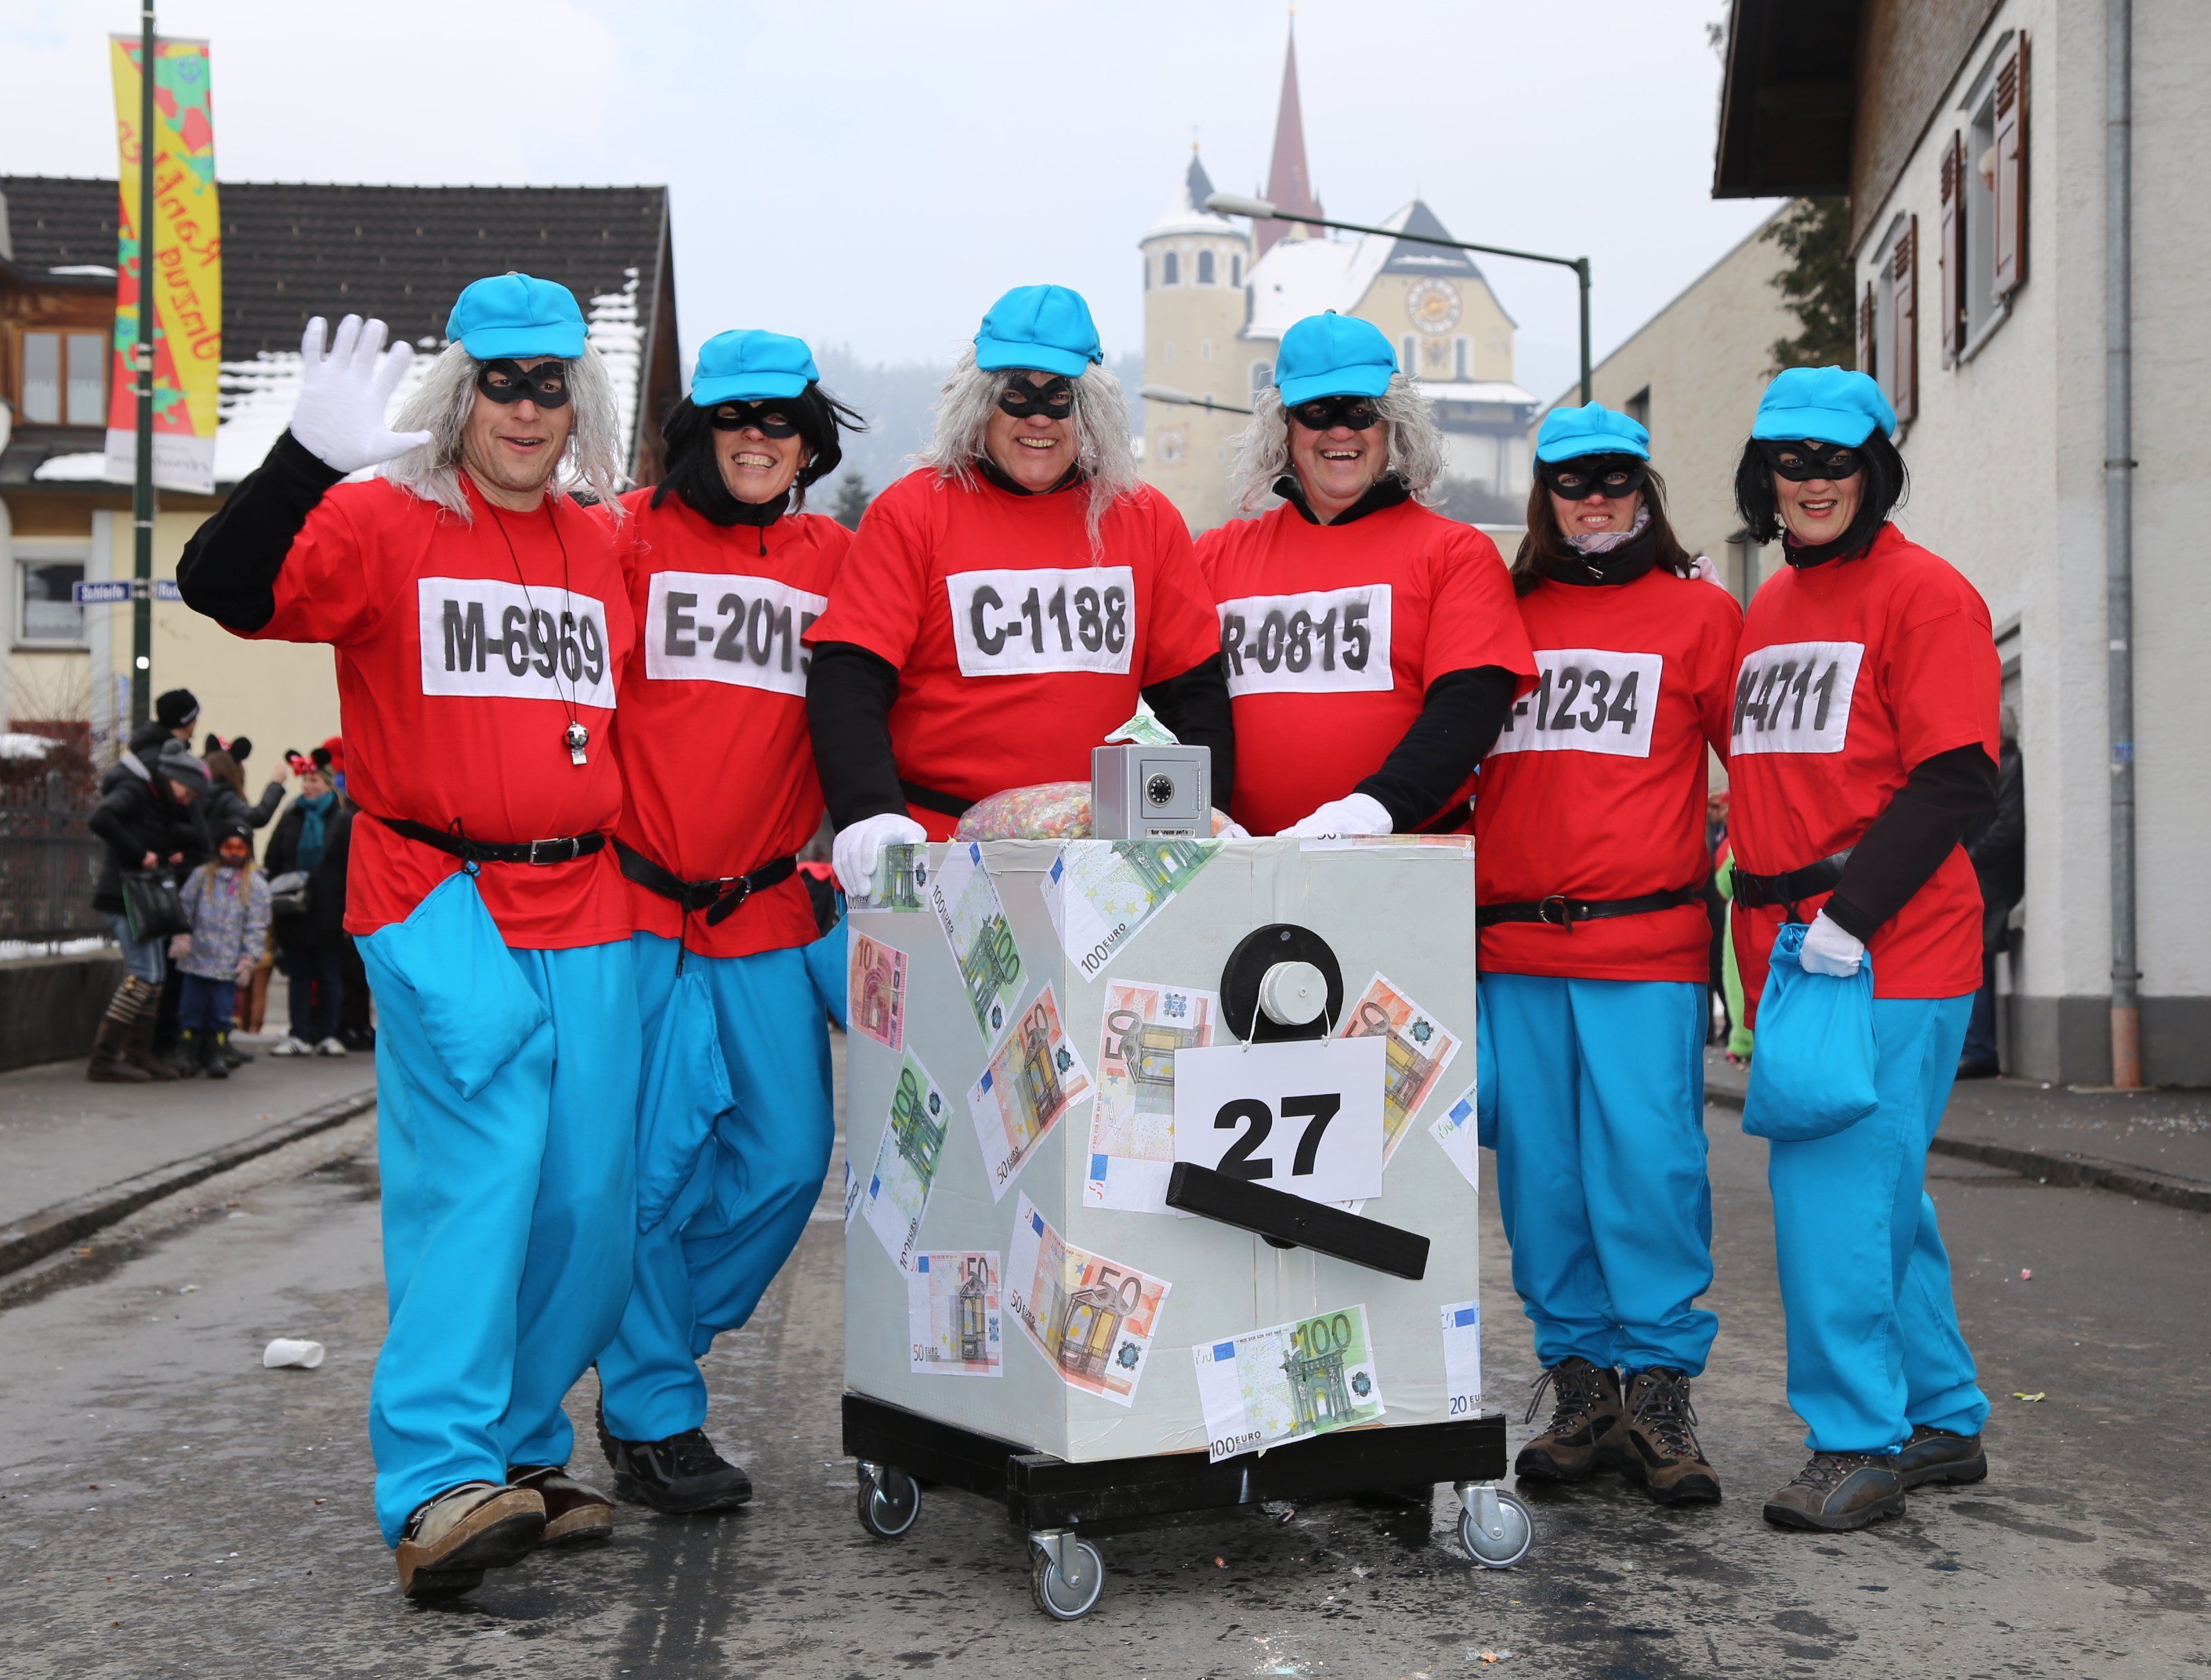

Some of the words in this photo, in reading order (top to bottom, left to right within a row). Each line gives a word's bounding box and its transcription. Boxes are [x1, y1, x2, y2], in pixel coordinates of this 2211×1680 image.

[443, 599, 604, 685] M-6969
[971, 586, 1126, 656] C-1188
[1221, 604, 1371, 679] R-0815
[1502, 666, 1640, 734] -1234
[932, 885, 946, 913] 100
[942, 908, 954, 933] EURO
[858, 937, 873, 971] 10
[991, 919, 1020, 986] 100
[1081, 944, 1109, 974] 100
[1102, 923, 1126, 948] EURO
[1105, 1010, 1144, 1062] 50
[892, 1068, 918, 1127] 100
[1213, 1093, 1341, 1182] 27
[996, 1161, 1008, 1185] 50
[1006, 1145, 1019, 1165] EURO
[907, 1217, 917, 1243] EURO
[967, 1257, 989, 1295] 50
[1090, 1266, 1142, 1317] 50
[1010, 1289, 1022, 1314] 50
[1022, 1304, 1036, 1324] EURO
[913, 1344, 924, 1362] 50
[924, 1346, 939, 1355] EURO
[1296, 1313, 1352, 1359] 100
[1449, 1395, 1467, 1415] 20
[1209, 1437, 1235, 1458] 100
[1235, 1431, 1262, 1444] EURO
